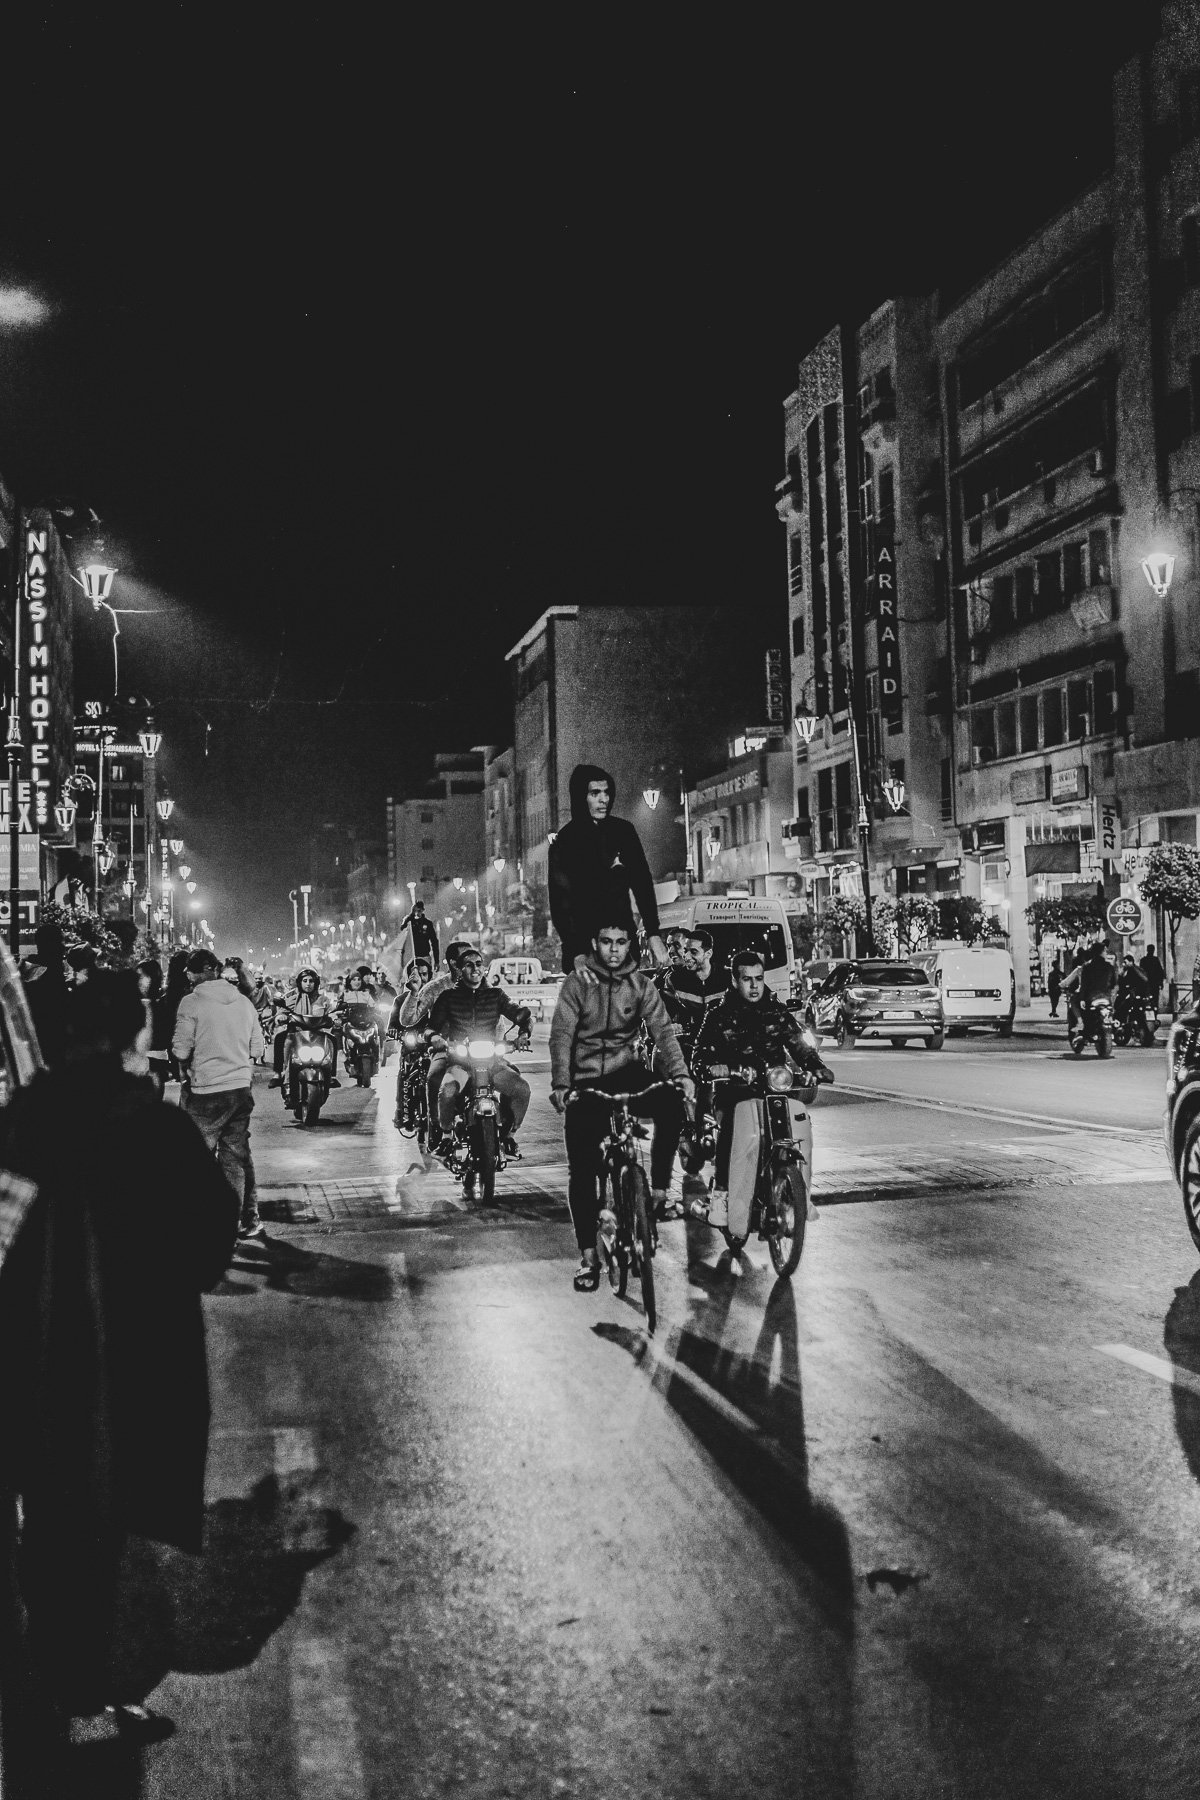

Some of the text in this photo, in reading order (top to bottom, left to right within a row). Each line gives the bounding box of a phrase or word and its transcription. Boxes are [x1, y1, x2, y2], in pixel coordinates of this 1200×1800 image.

[878, 547, 897, 694] ARRAID
[28, 532, 50, 787] NASSIM HOTEL
[76, 743, 96, 751] HOTEL
[1102, 803, 1117, 850] Hertz
[706, 902, 757, 910] TROPICAL
